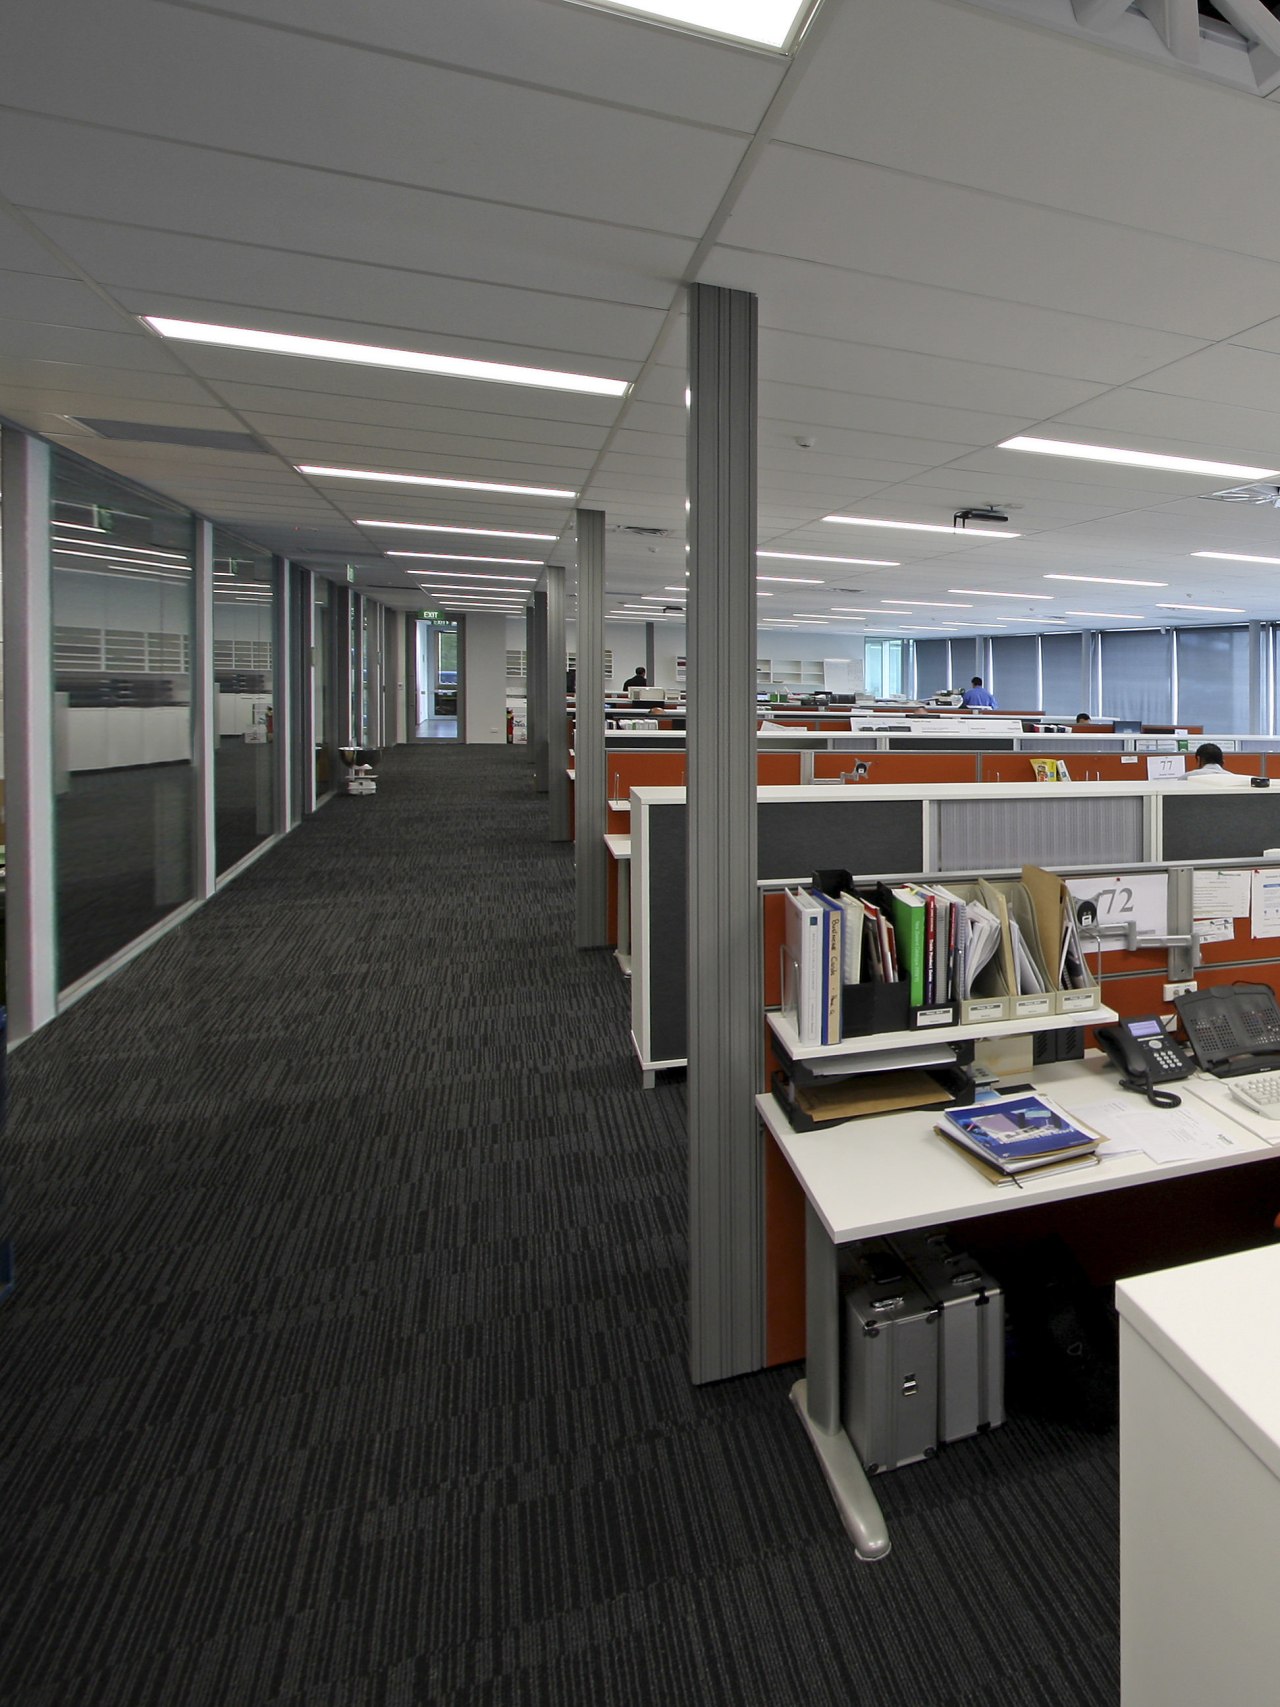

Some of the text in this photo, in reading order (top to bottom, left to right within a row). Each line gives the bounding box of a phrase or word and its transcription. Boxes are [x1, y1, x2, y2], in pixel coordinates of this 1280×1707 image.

[423, 611, 439, 619] EXIT
[1160, 760, 1173, 771] 77
[1101, 887, 1134, 914] 72
